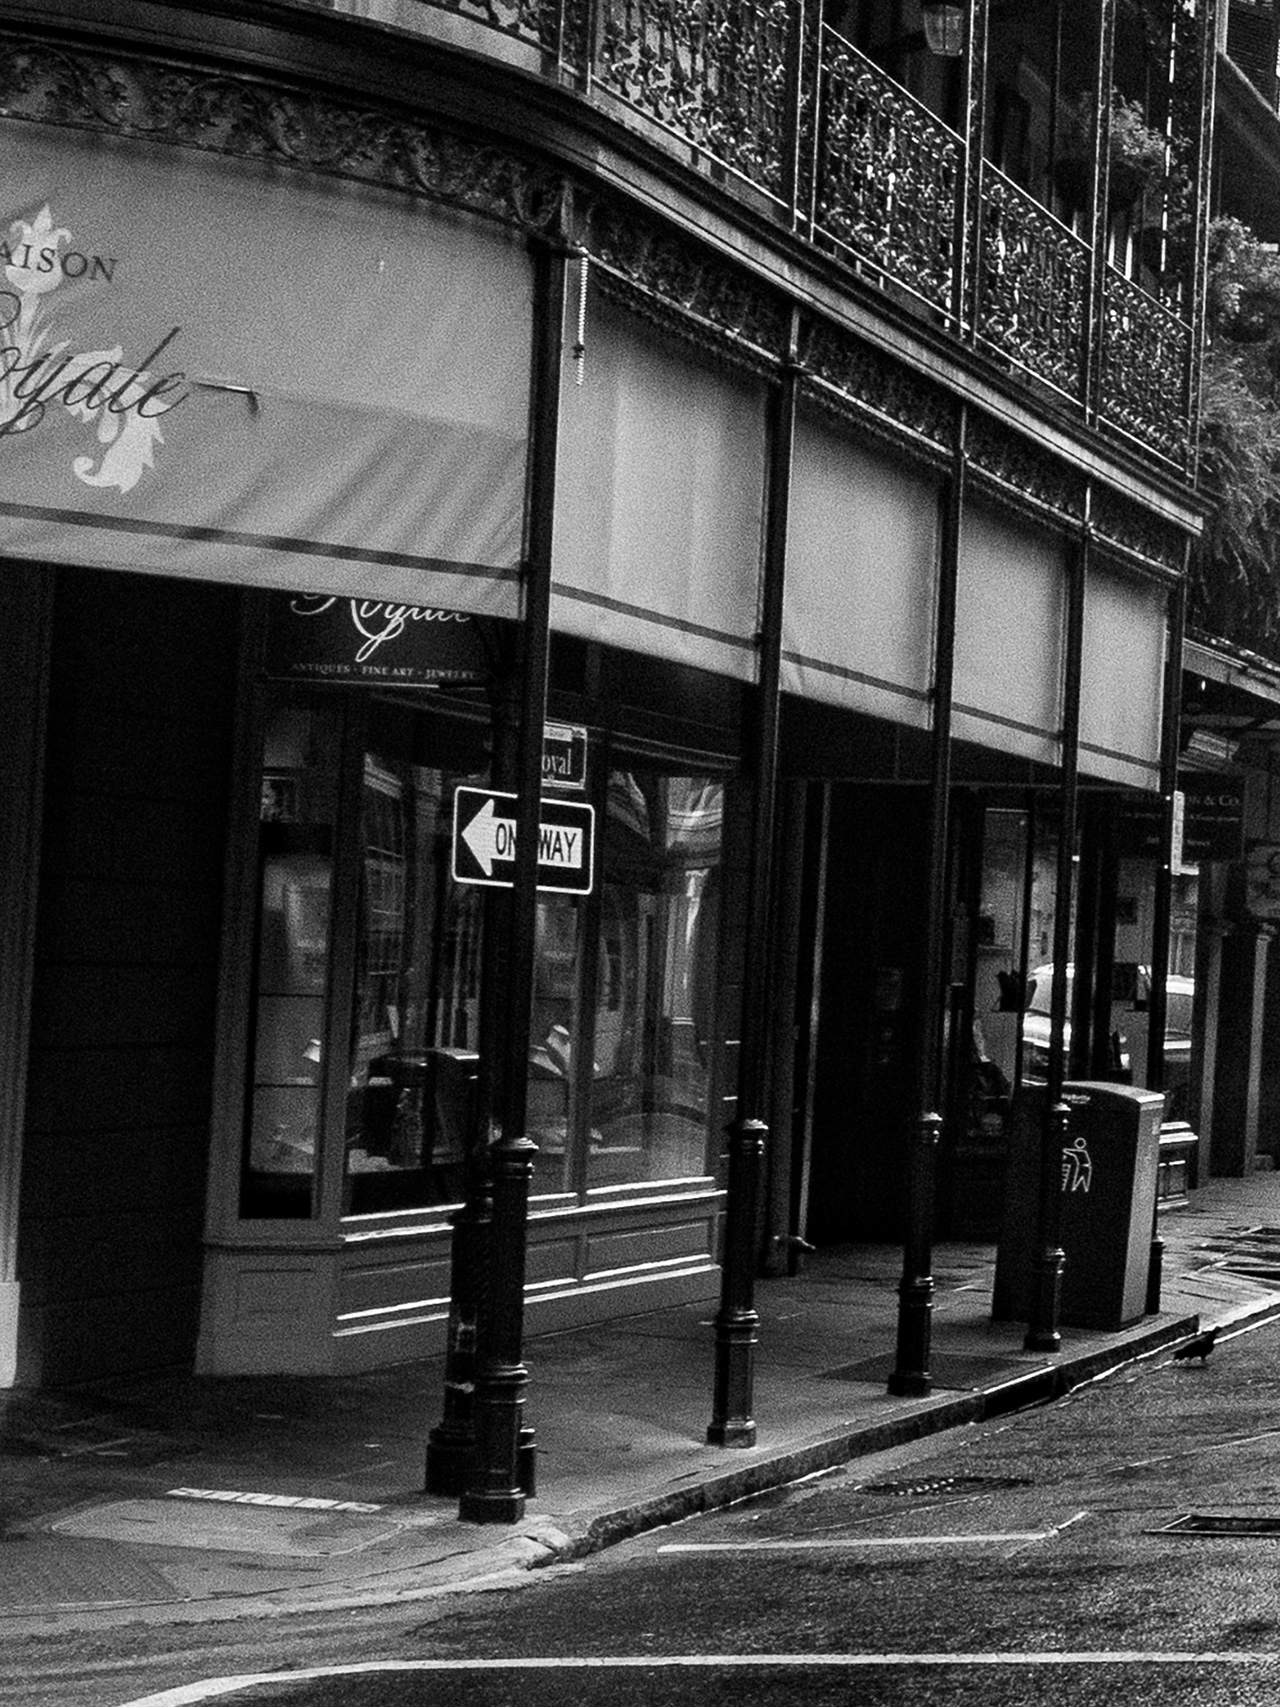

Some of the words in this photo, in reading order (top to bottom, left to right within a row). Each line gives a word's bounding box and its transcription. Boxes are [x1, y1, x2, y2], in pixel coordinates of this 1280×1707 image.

[292, 662, 350, 674] ANTIQUES
[362, 665, 388, 675] FINE
[391, 667, 415, 677] ART
[541, 748, 572, 780] oyal
[495, 822, 516, 857] ON
[538, 827, 578, 863] WAY
